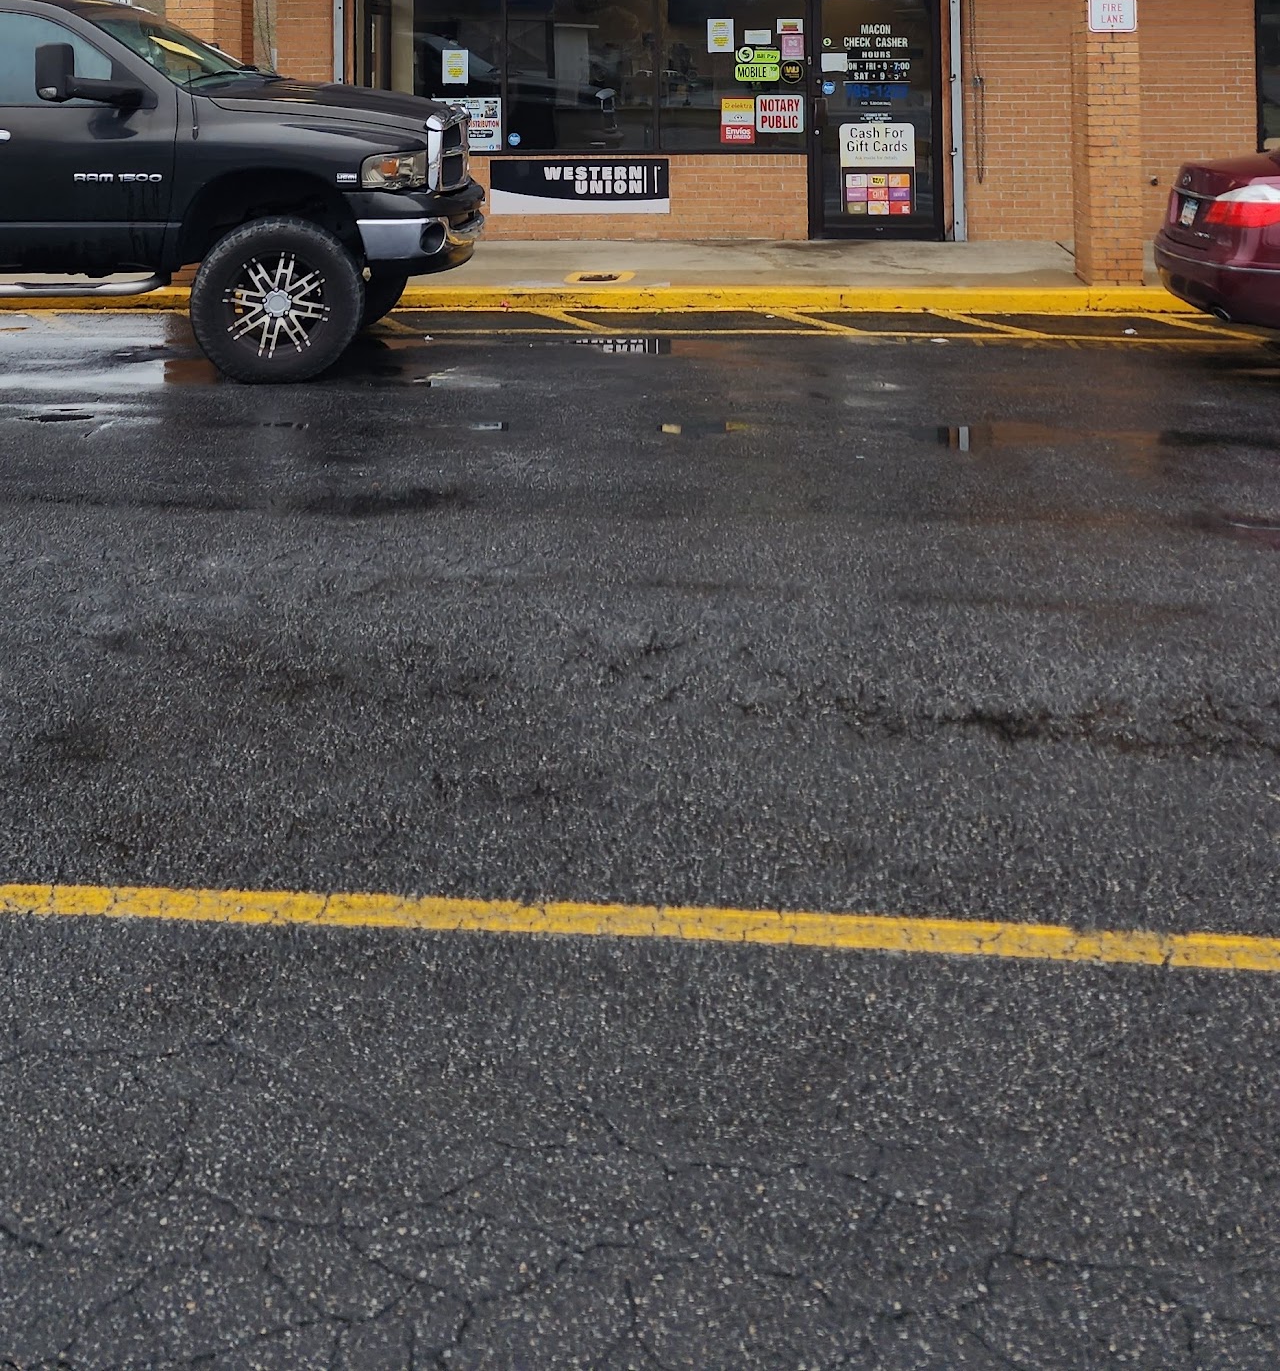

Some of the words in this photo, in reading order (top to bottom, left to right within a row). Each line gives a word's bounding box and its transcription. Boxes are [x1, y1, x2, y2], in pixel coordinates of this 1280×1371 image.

[1102, 3, 1123, 12] FIRE
[1101, 14, 1124, 24] LANE
[861, 24, 891, 35] MACON
[843, 37, 871, 48] CHECK
[875, 37, 908, 48] CASHER
[848, 62, 857, 70] ON
[865, 62, 876, 70] FRI
[737, 66, 767, 78] MOBILE
[853, 72, 869, 80] SAT
[760, 99, 800, 112] NOTARY
[761, 115, 798, 129] PUBLIC
[849, 126, 880, 139] Cash
[884, 127, 905, 139] For
[846, 139, 869, 152] Gift
[873, 140, 908, 152] Cards
[73, 173, 114, 182] RAM
[118, 173, 163, 182] 1500
[543, 166, 643, 180] WESTERN
[574, 180, 643, 194] UNION
